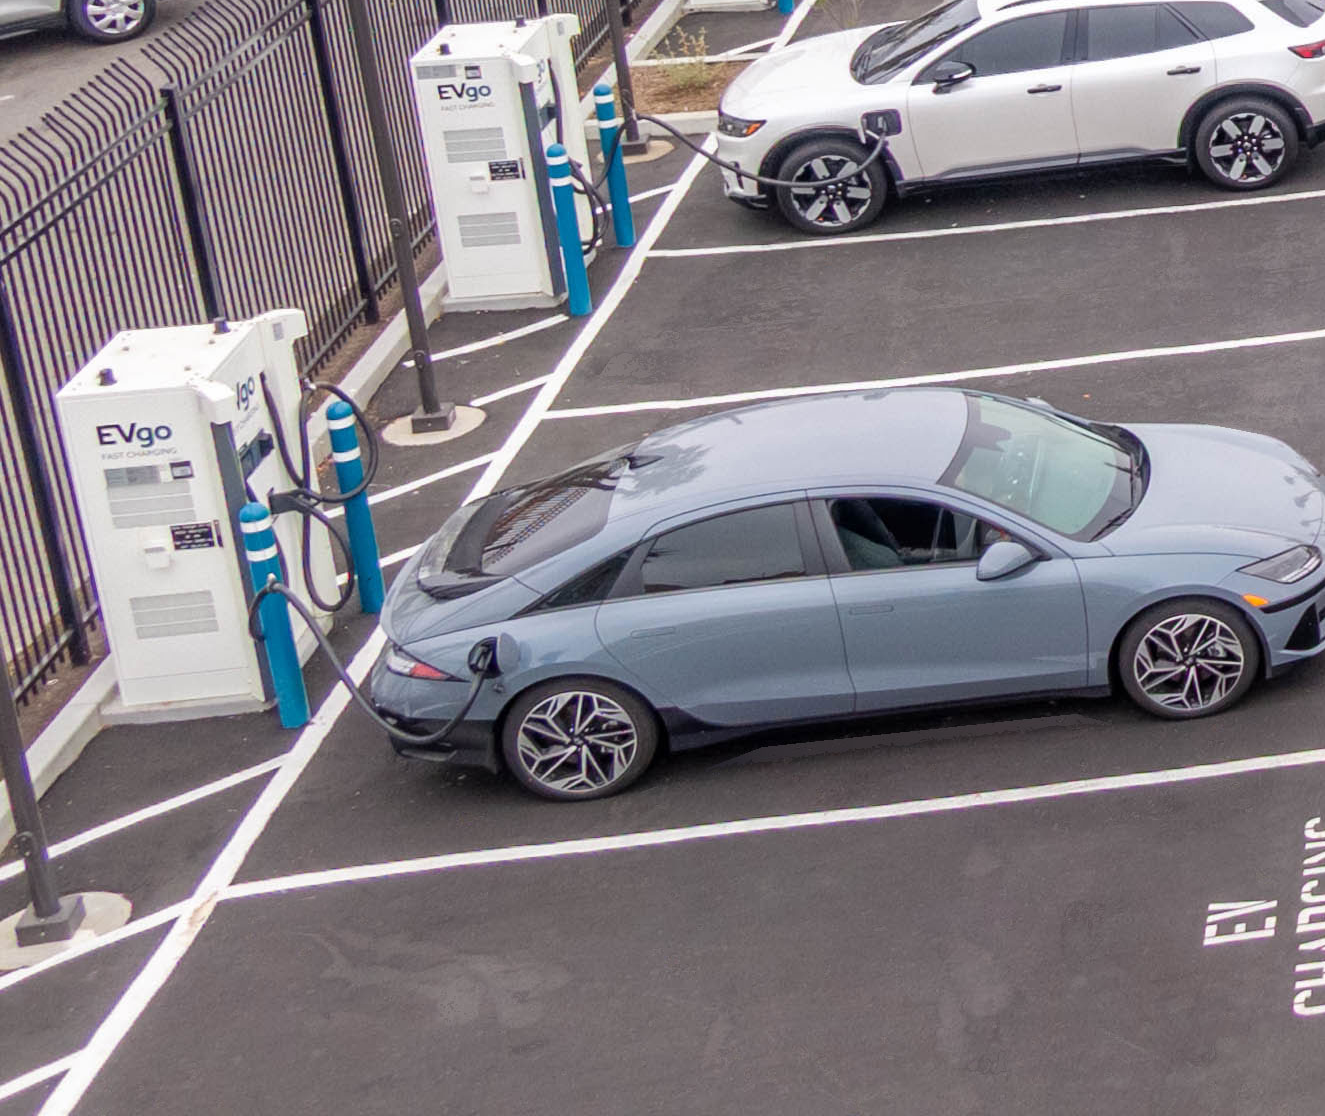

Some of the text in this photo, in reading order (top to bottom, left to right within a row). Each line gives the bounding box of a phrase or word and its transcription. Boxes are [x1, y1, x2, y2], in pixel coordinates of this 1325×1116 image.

[437, 83, 492, 102] EVgo
[96, 422, 172, 448] EVgo
[101, 447, 178, 461] FAST CHARGING
[1203, 900, 1278, 946] EV
